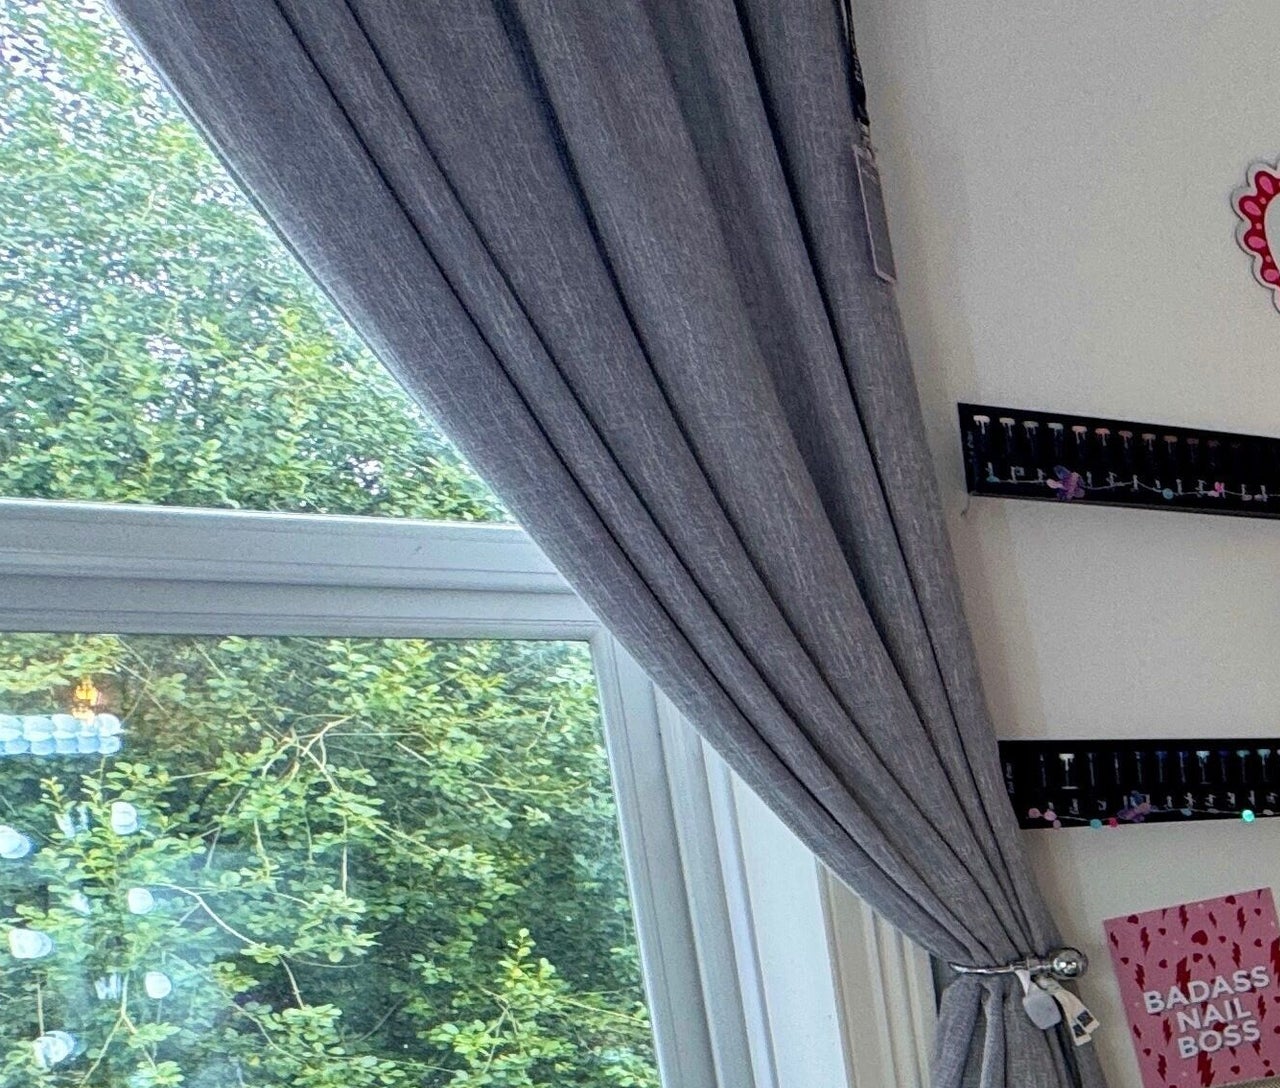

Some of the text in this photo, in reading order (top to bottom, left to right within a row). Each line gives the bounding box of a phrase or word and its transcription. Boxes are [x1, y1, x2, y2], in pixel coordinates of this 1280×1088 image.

[1143, 965, 1270, 1014] BADASS
[1175, 997, 1253, 1035] NAIL
[1177, 1018, 1261, 1060] BOSS
